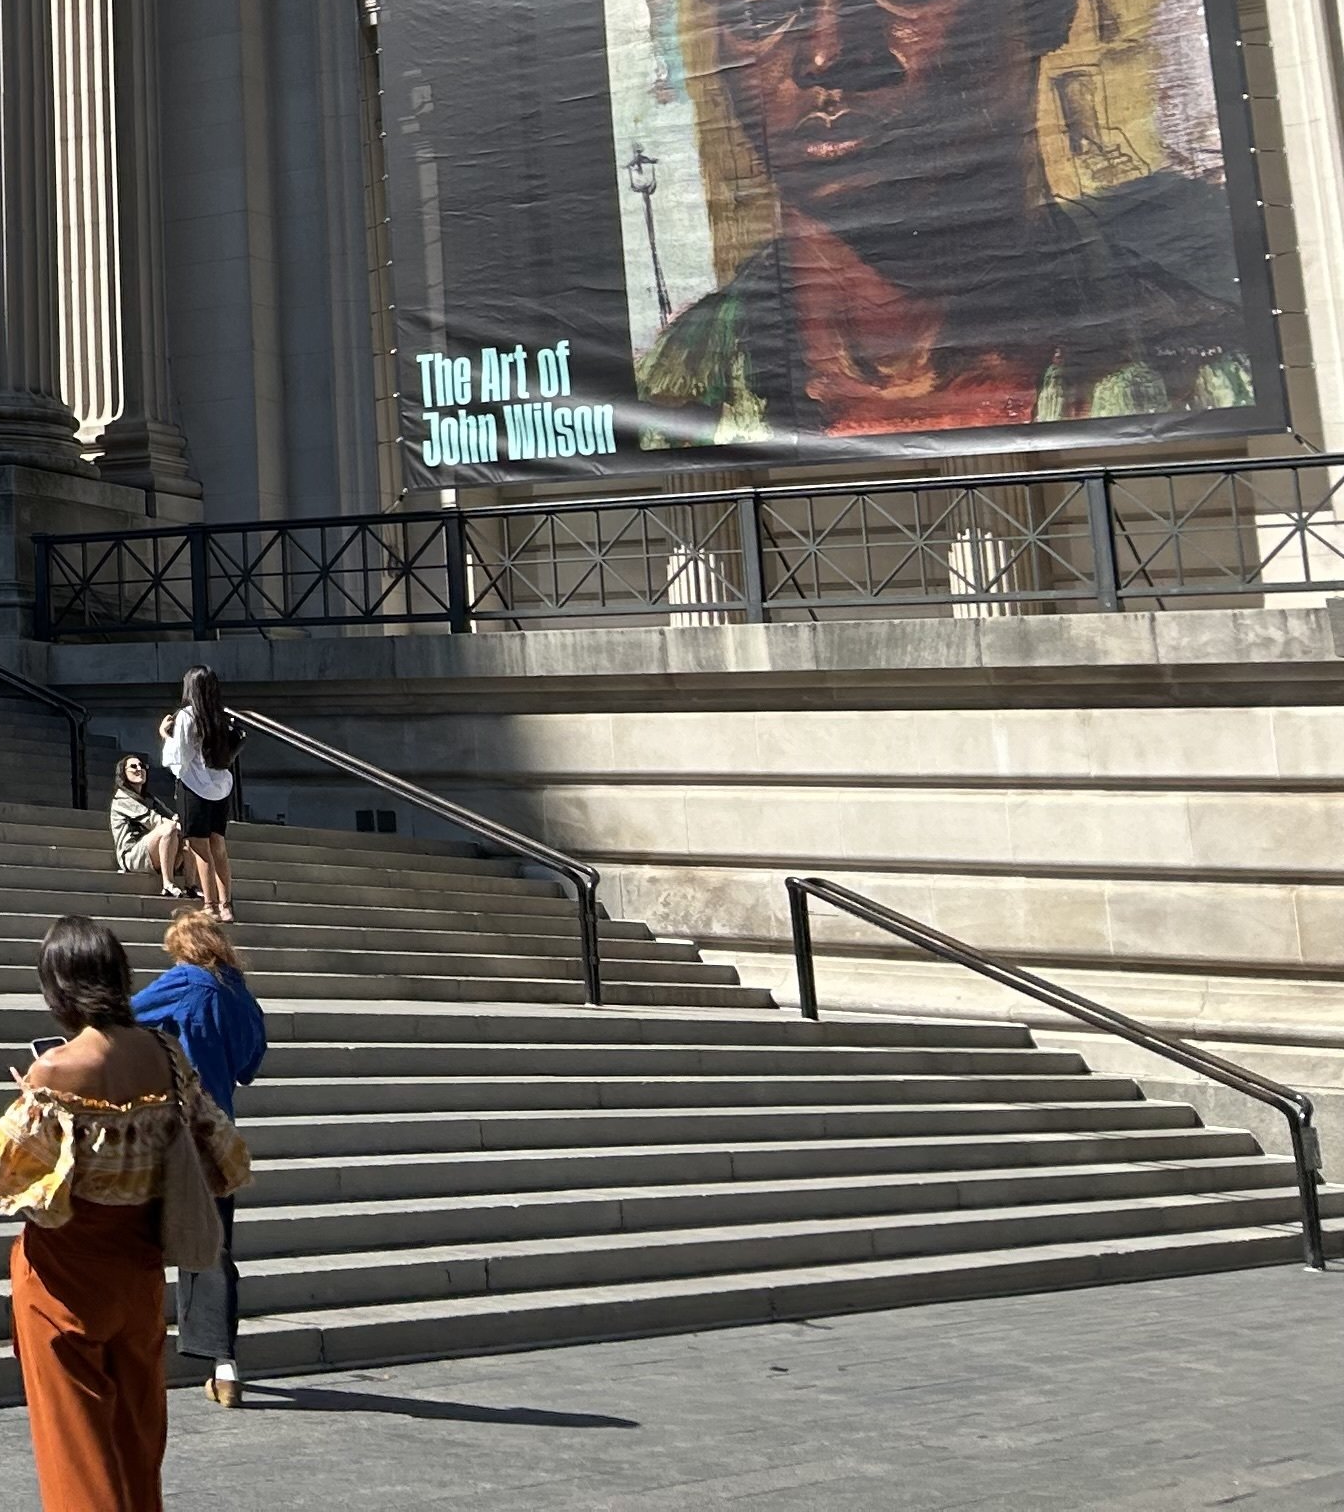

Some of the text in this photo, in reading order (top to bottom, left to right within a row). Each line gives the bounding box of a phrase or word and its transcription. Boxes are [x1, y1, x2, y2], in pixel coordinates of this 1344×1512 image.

[416, 340, 571, 408] The Art of
[422, 402, 616, 467] John Wilson
